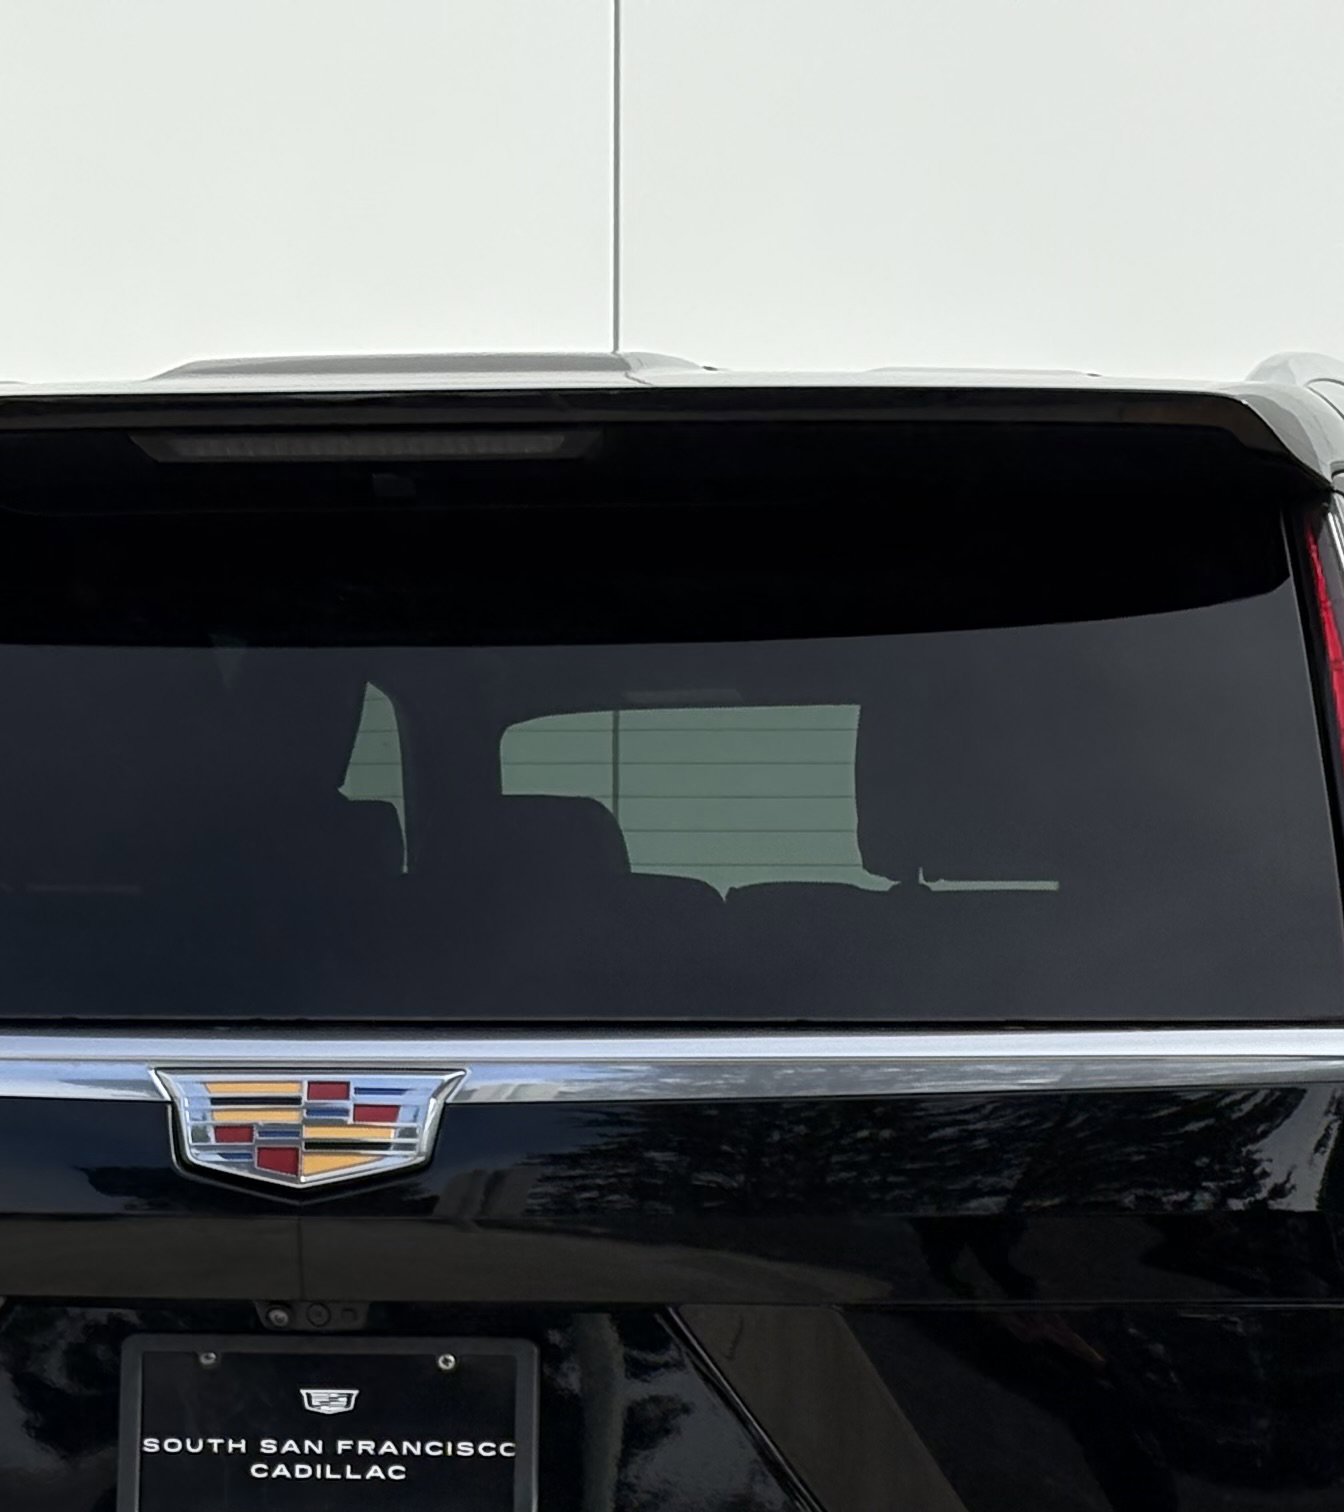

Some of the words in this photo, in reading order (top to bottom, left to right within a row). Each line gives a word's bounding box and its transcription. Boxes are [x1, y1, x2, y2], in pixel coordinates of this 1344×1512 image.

[142, 1437, 247, 1454] SOUTH
[259, 1438, 323, 1455] SAN
[250, 1463, 406, 1480] CADILLAC
